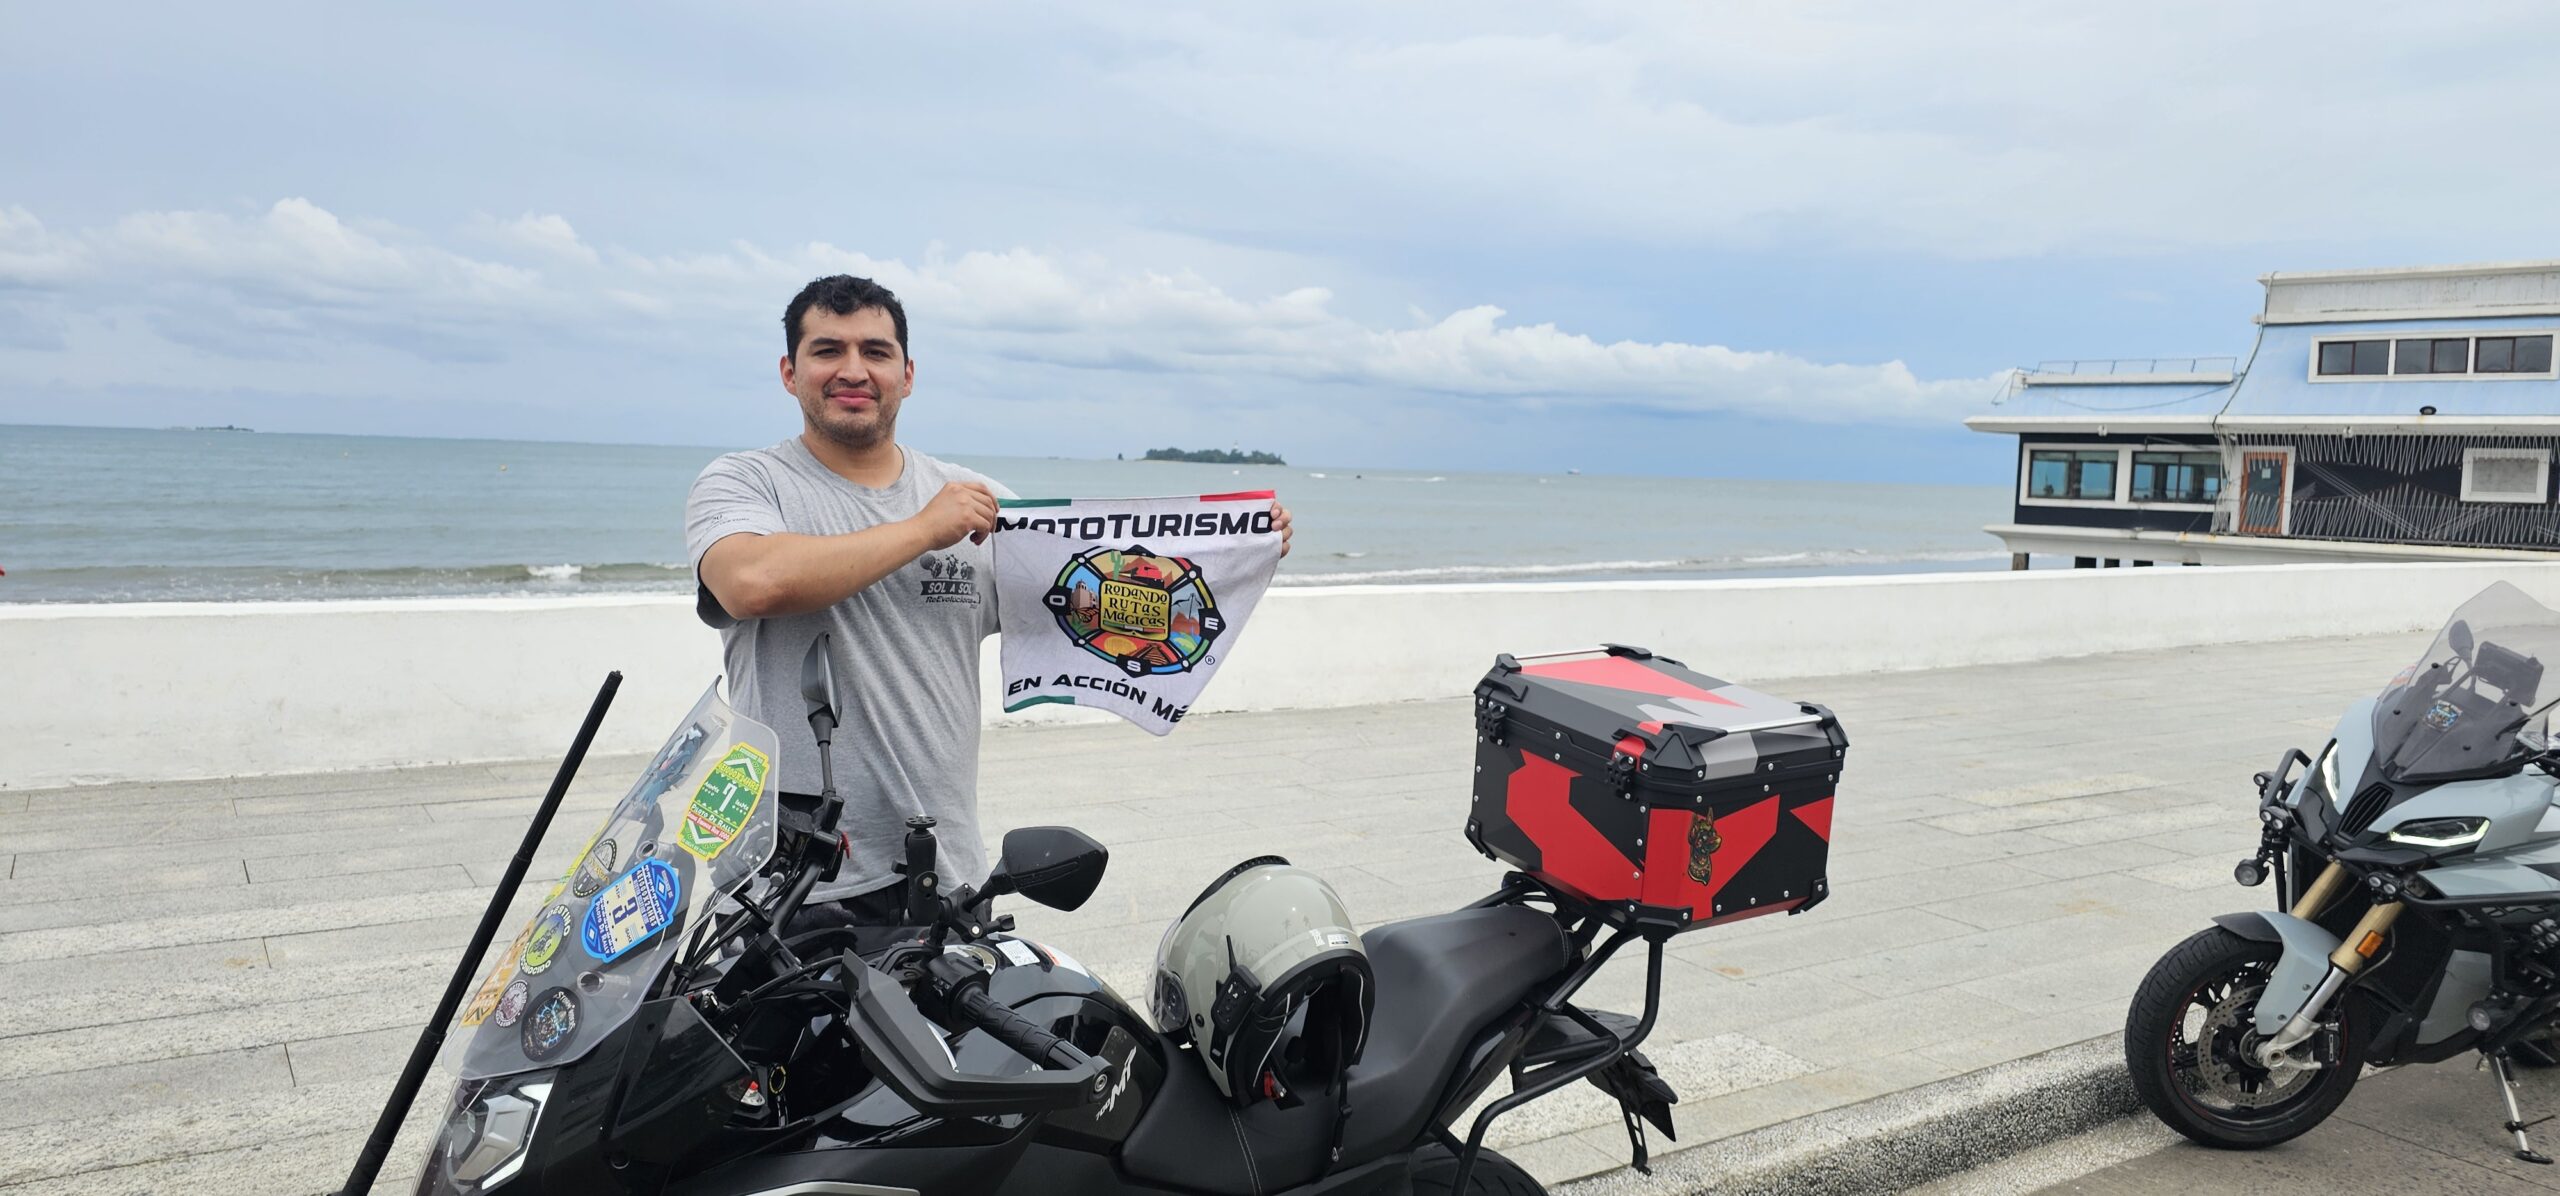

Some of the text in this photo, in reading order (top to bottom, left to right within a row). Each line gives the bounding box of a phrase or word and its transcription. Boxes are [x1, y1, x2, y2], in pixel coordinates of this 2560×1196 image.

[994, 511, 1273, 540] MOTOTURISMO
[928, 582, 972, 594] SOL A SOL
[1204, 616, 1219, 631] E
[1126, 660, 1141, 672] S
[1007, 676, 1042, 696] EN
[1052, 674, 1147, 705] ACCIÓN
